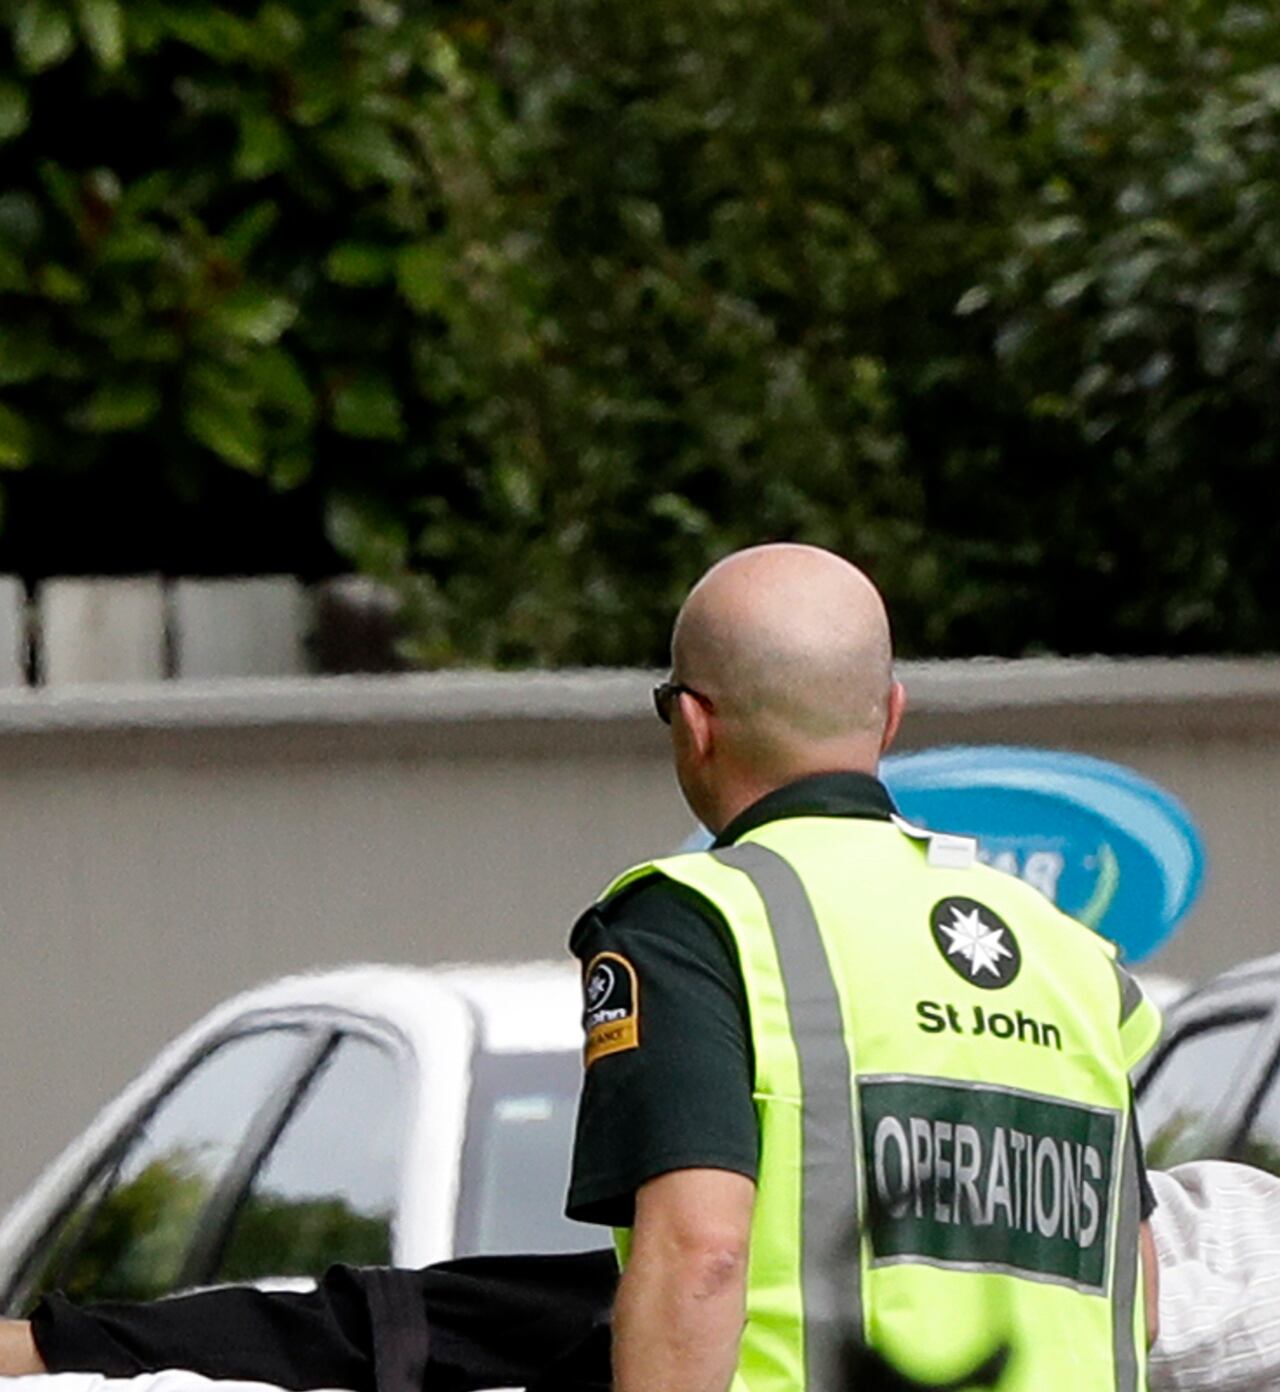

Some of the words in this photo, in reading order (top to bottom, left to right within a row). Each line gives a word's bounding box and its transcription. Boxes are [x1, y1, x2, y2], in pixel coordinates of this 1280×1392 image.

[916, 1000, 964, 1036] St
[971, 1005, 1062, 1051] John
[873, 1115, 1102, 1249] OPERATIONS
